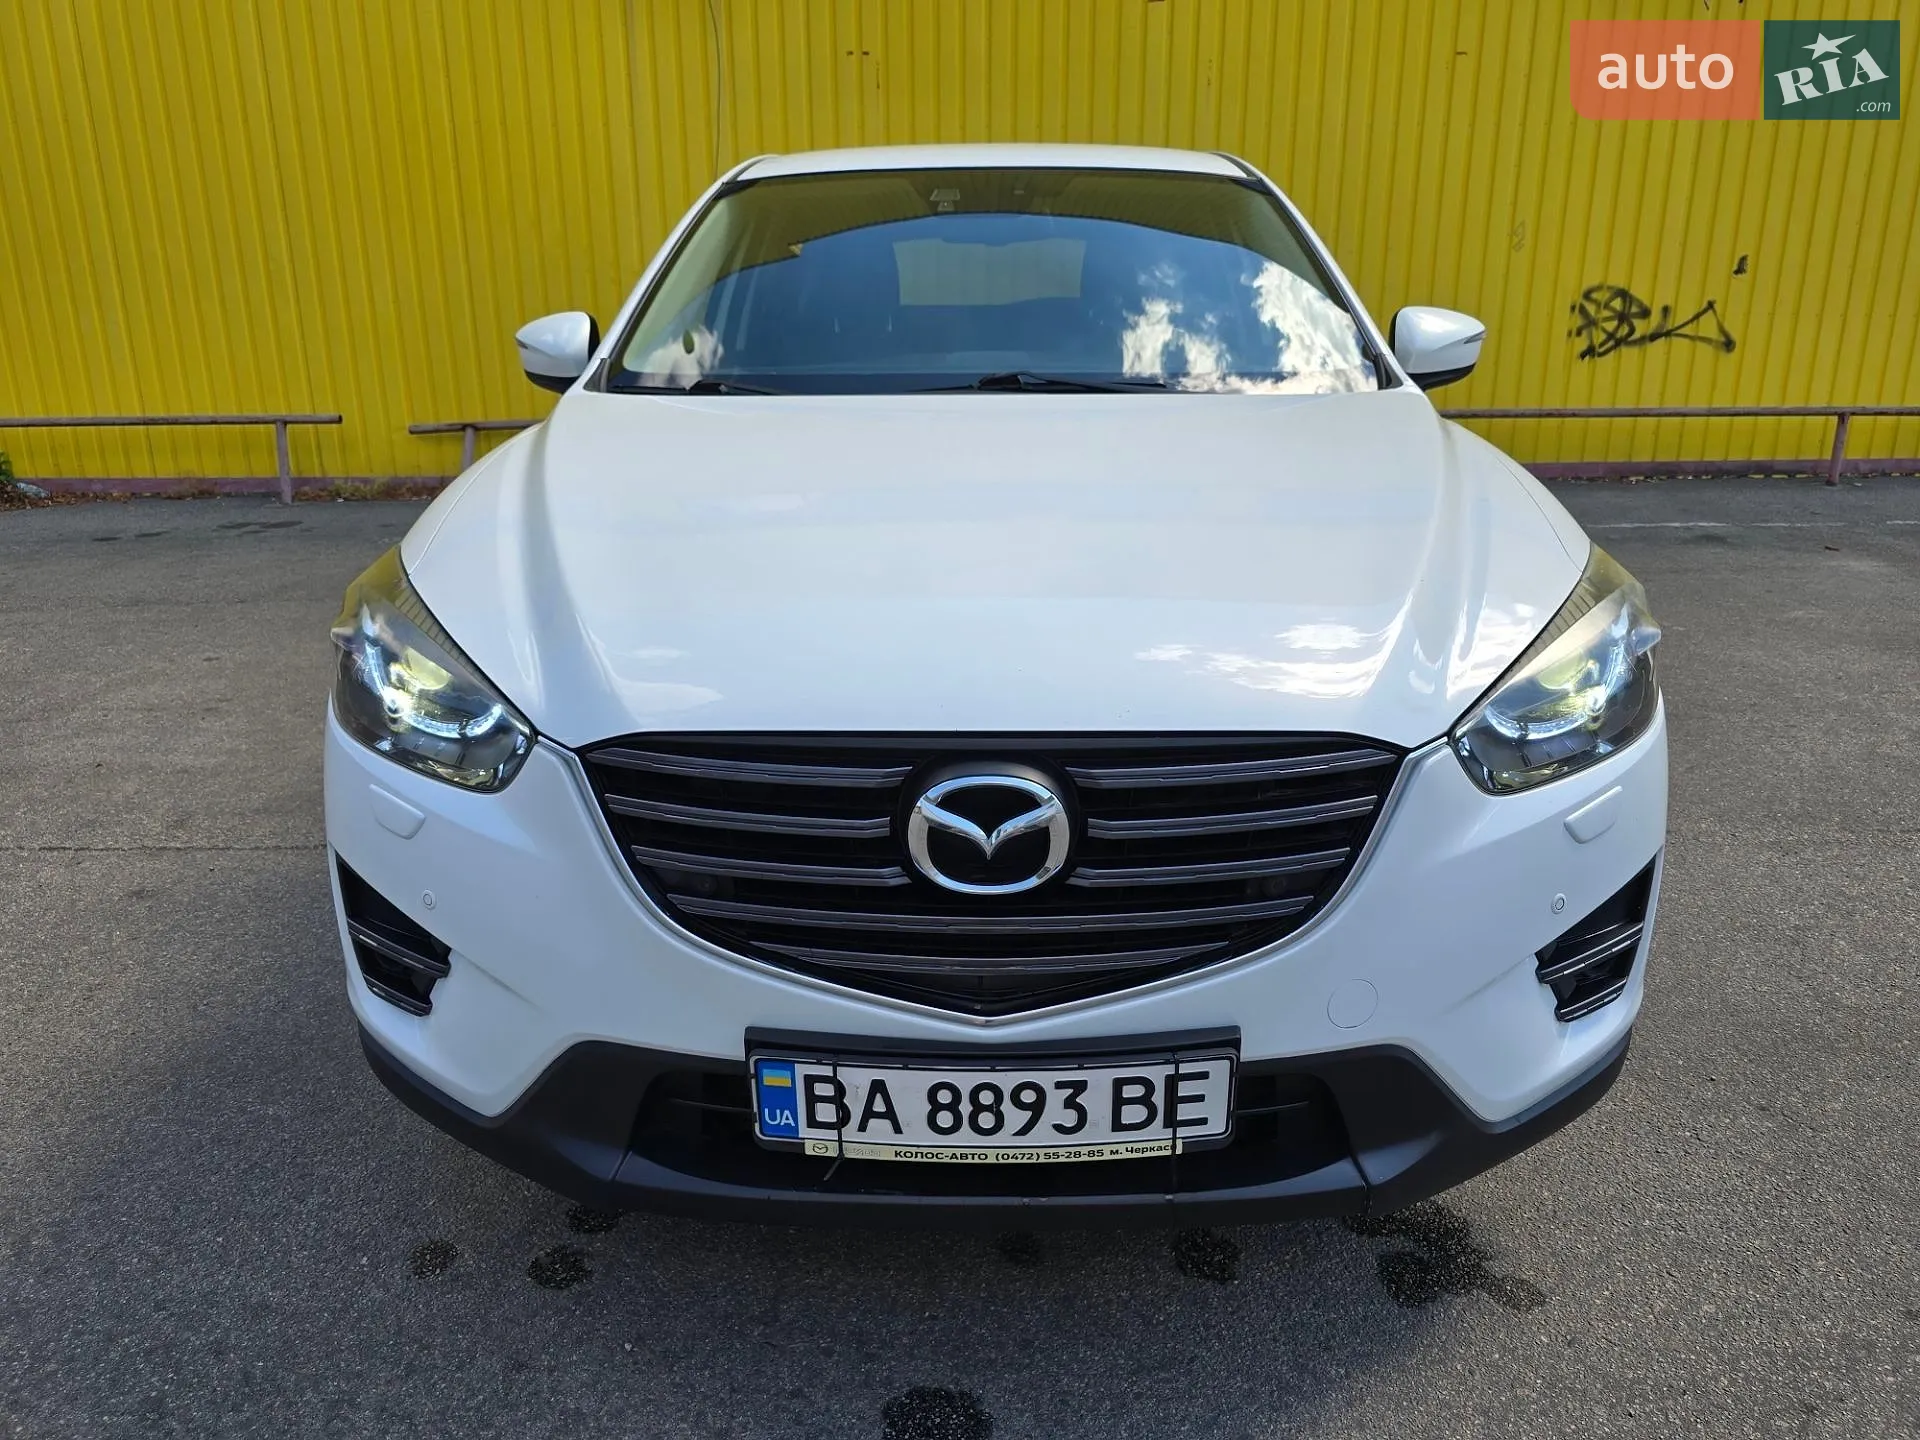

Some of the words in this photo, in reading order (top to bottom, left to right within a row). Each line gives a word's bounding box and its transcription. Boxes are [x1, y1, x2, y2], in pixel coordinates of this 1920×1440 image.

[803, 1073, 904, 1135] BA
[926, 1080, 1089, 1137] 8893
[1111, 1070, 1210, 1133] BE
[764, 1108, 796, 1127] UA
[894, 1150, 988, 1162] КОЛОС-АВТО
[995, 1151, 1041, 1162] (0472)
[1043, 1149, 1105, 1161] 55-28-85
[1125, 1144, 1176, 1155] Черкас
